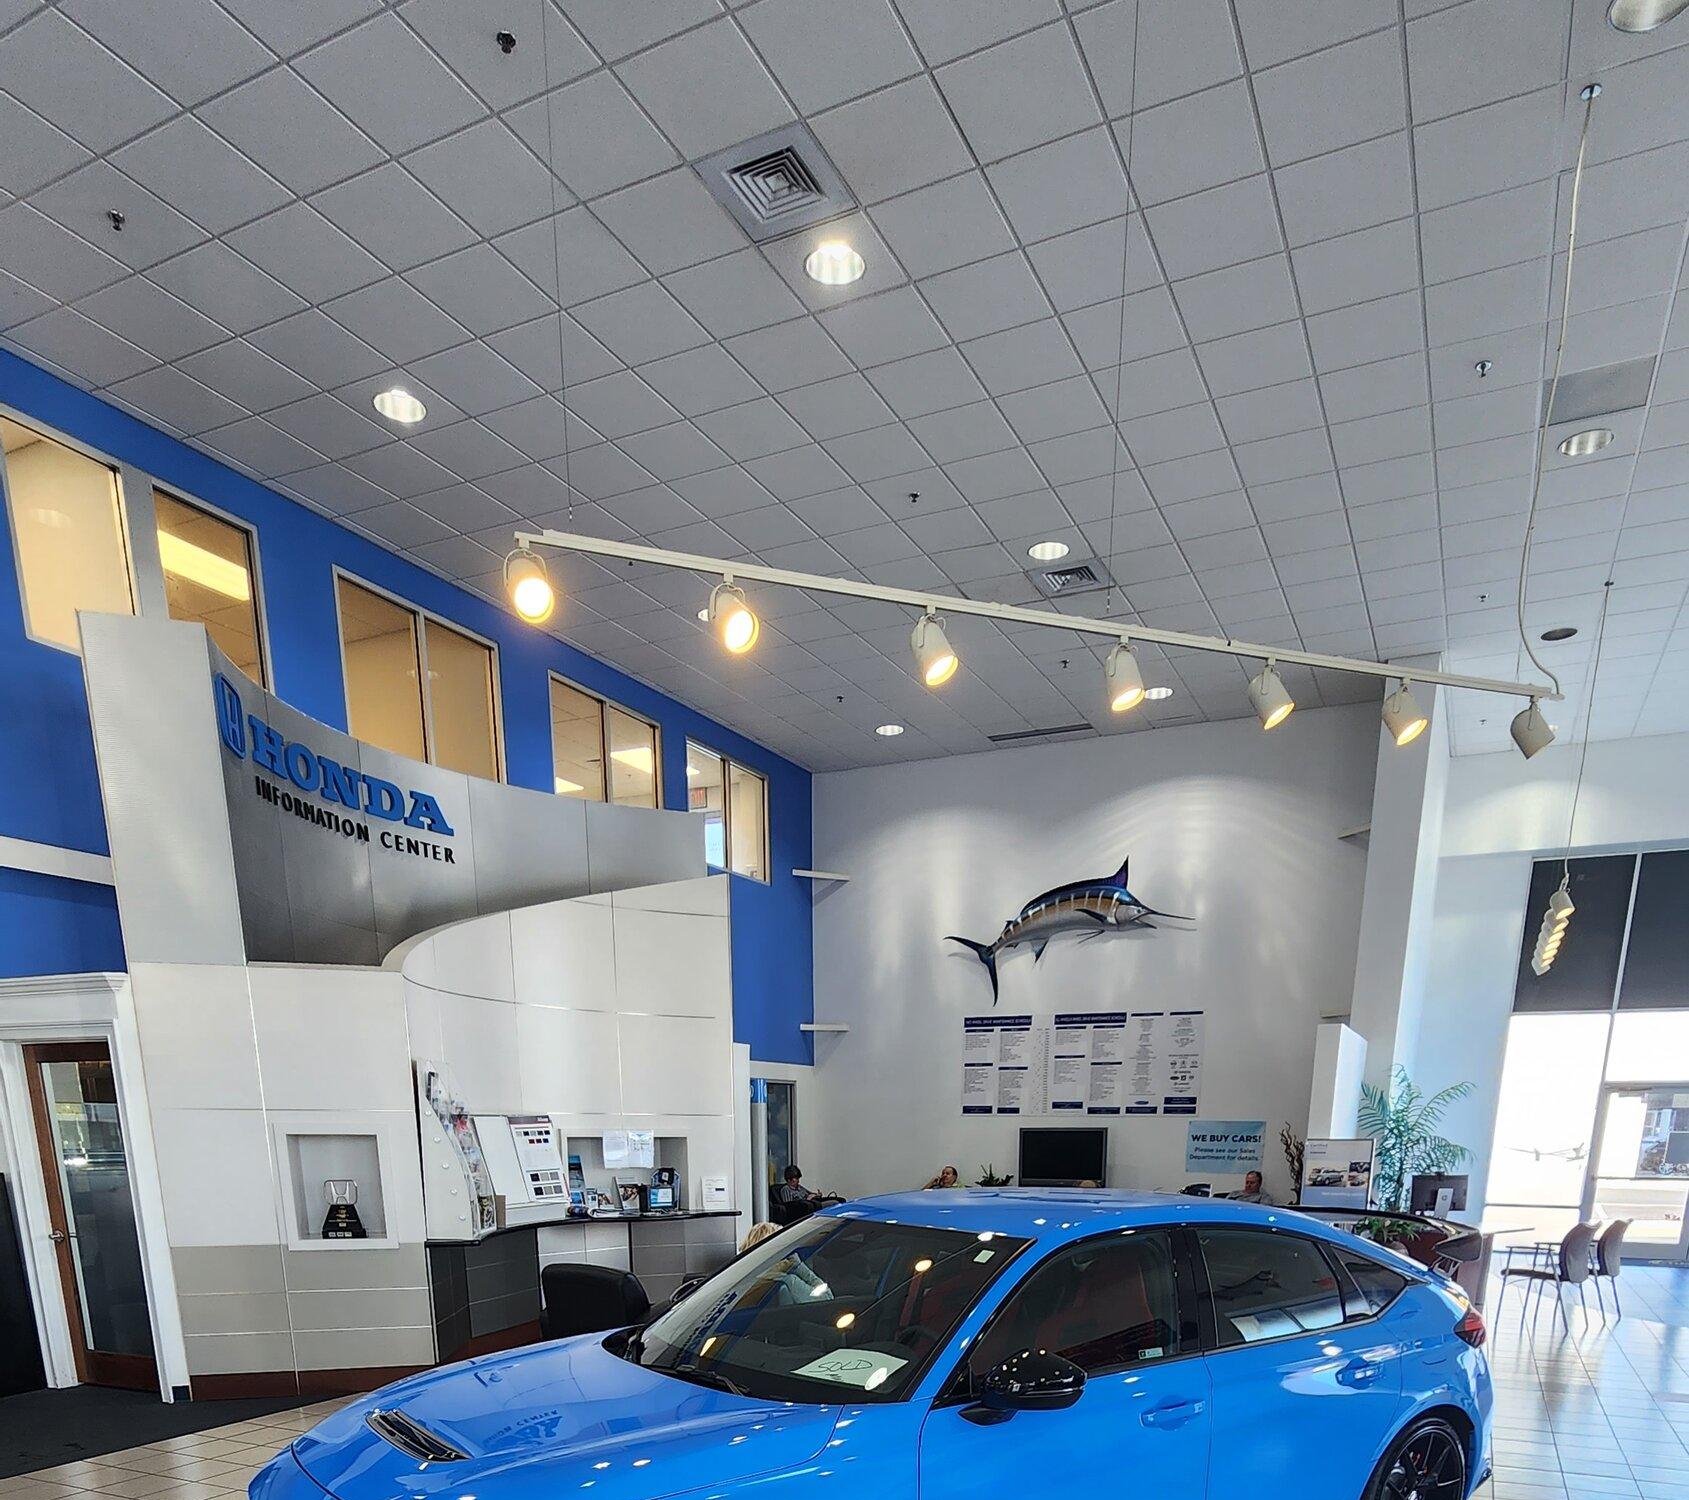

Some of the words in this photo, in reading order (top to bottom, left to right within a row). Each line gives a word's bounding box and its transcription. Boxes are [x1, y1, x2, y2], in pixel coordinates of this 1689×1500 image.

[248, 714, 455, 836] HONDA
[255, 776, 370, 842] INFORMATION
[380, 831, 456, 864] CENTER
[1191, 1134, 1207, 1142] WE
[1210, 1134, 1229, 1142] BUY
[1231, 1135, 1262, 1143] CARS!
[808, 1359, 873, 1372] SOLD
